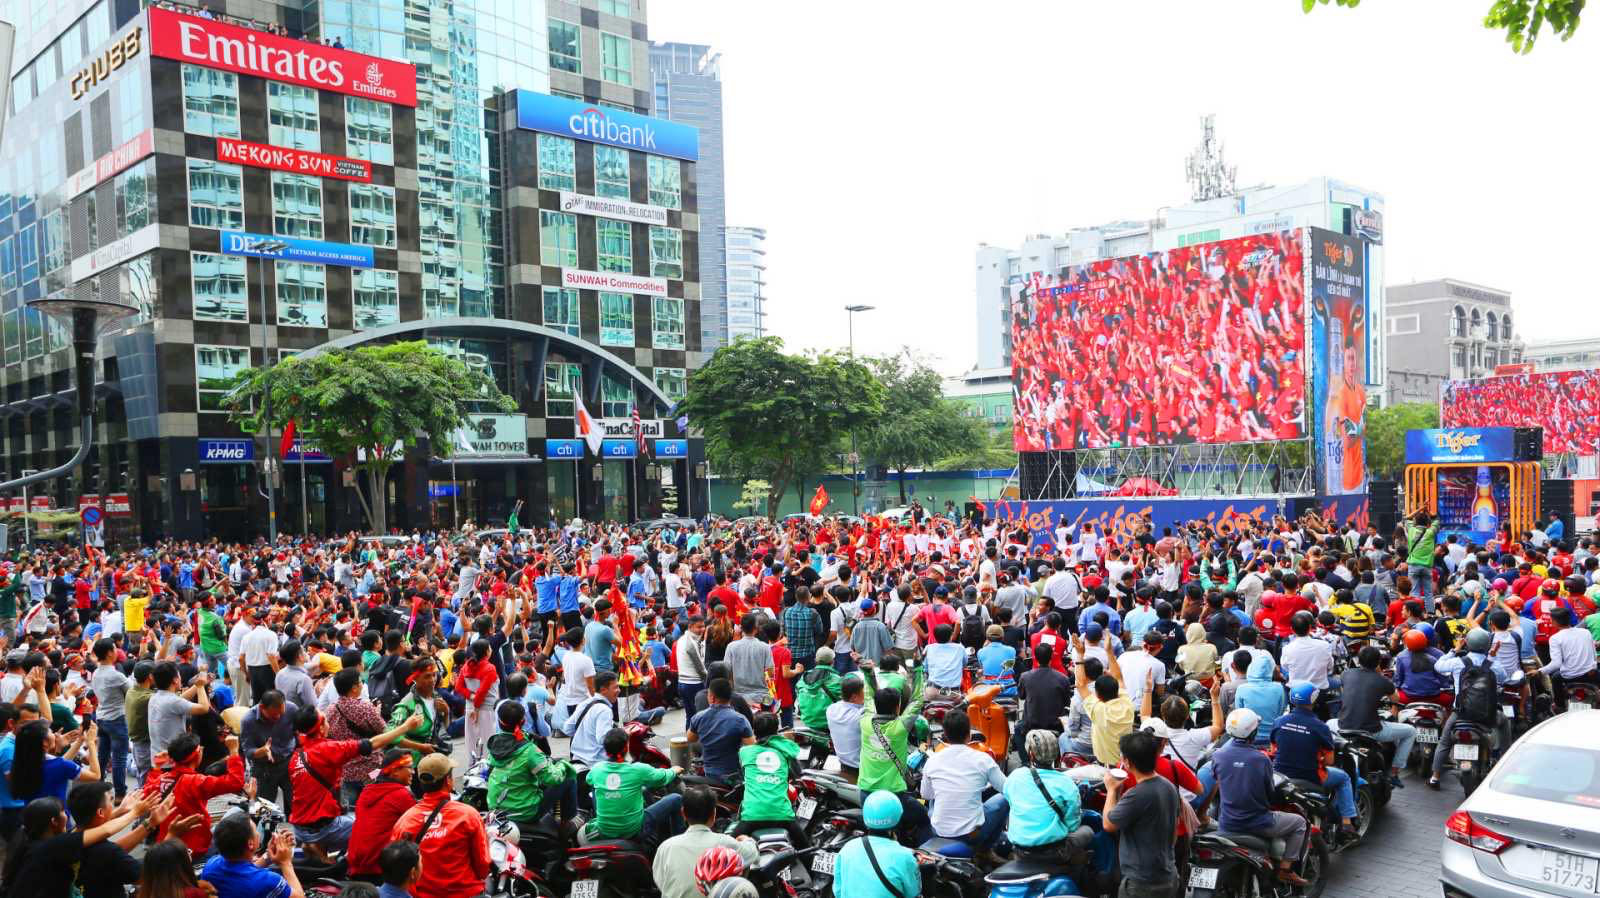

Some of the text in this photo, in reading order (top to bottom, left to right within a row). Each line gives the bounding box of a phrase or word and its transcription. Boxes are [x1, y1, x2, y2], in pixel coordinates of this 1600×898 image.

[177, 20, 345, 87] Emirates
[70, 26, 142, 100] CHUBB
[353, 80, 397, 99] Emirates
[569, 109, 657, 150] citibank
[221, 141, 332, 173] MEKONG SUN
[337, 160, 365, 170] VIETNAM
[333, 167, 369, 178] COFFEE
[289, 249, 316, 257] VIETNAM
[340, 254, 366, 262] AMERICA
[566, 273, 665, 293] SUNWAH Commodities
[600, 422, 660, 435] inaCaital
[494, 441, 525, 452] TOWER
[556, 443, 573, 455] citi
[612, 443, 627, 455] citi
[664, 442, 678, 454] citi
[1433, 431, 1482, 454] Tiger
[206, 448, 245, 459] KPMG
[1555, 852, 1585, 872] 51H
[1543, 866, 1594, 890] 517.73
